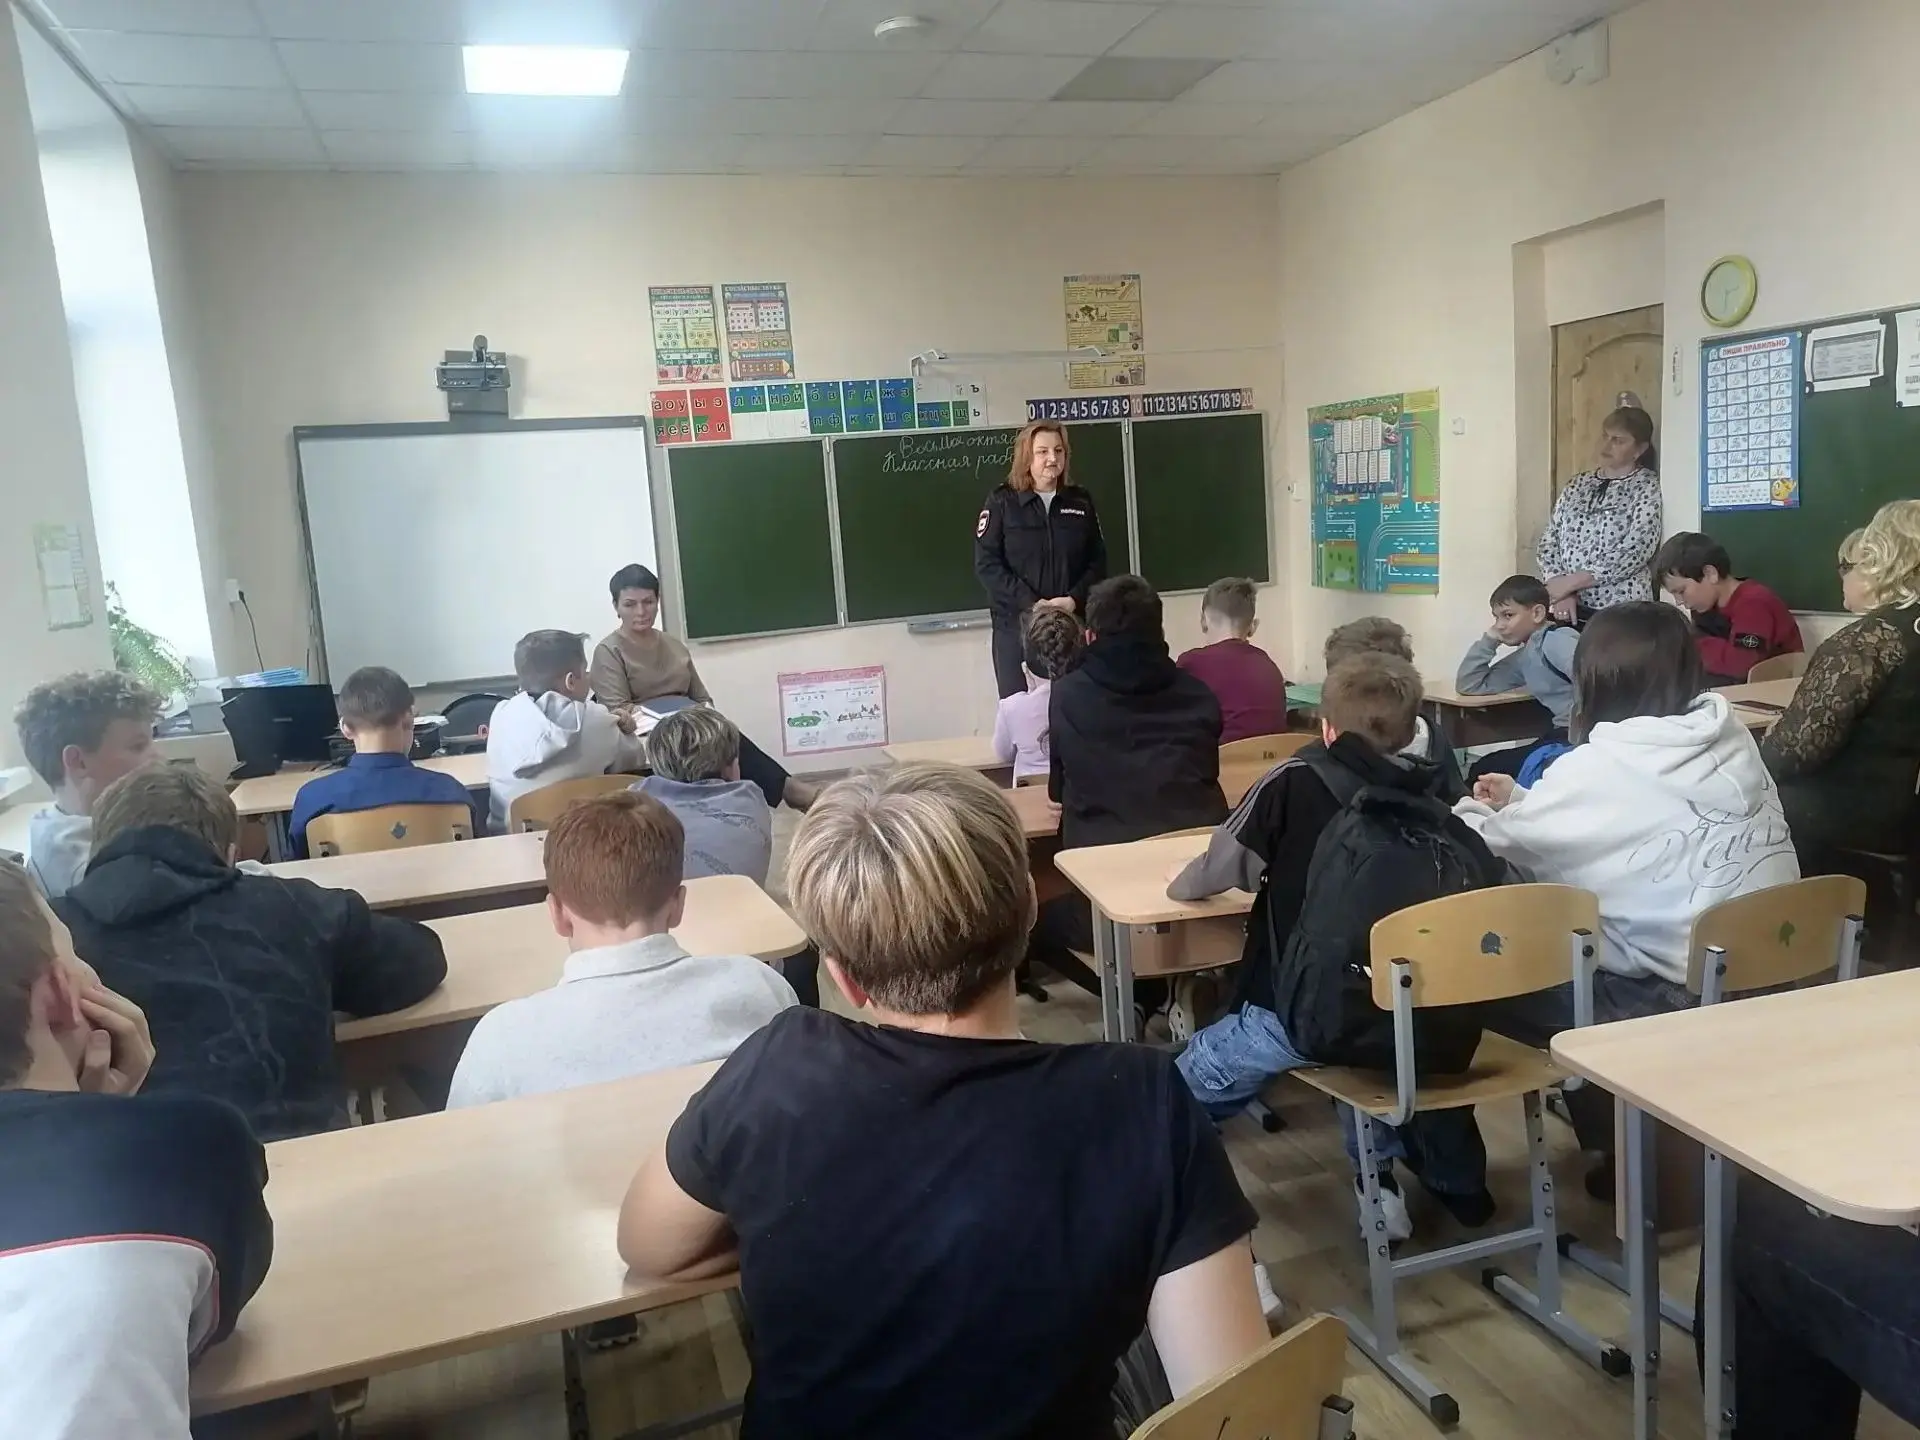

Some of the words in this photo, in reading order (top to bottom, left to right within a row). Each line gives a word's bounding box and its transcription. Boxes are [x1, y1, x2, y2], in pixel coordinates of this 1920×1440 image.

[1744, 339, 1787, 352] ПРАВИЛЬНО
[1028, 403, 1036, 420] 0
[1040, 402, 1046, 419] 1
[1049, 402, 1058, 419] 2
[1060, 401, 1068, 418] 3
[1070, 401, 1078, 417] 4
[1081, 401, 1089, 417] 5
[1091, 400, 1099, 416] 6
[1101, 399, 1109, 416] 7
[1112, 399, 1120, 415] 8
[1122, 398, 1130, 415] 9
[1131, 398, 1143, 414] 10
[1143, 396, 1153, 413] 11
[1154, 397, 1165, 413] 12
[1166, 396, 1176, 412] 13
[1177, 395, 1188, 411] 14
[1189, 395, 1198, 411] 15
[1200, 394, 1210, 410] 16
[1210, 394, 1220, 409] 17
[1221, 393, 1231, 409] 18
[1231, 392, 1241, 408] 19
